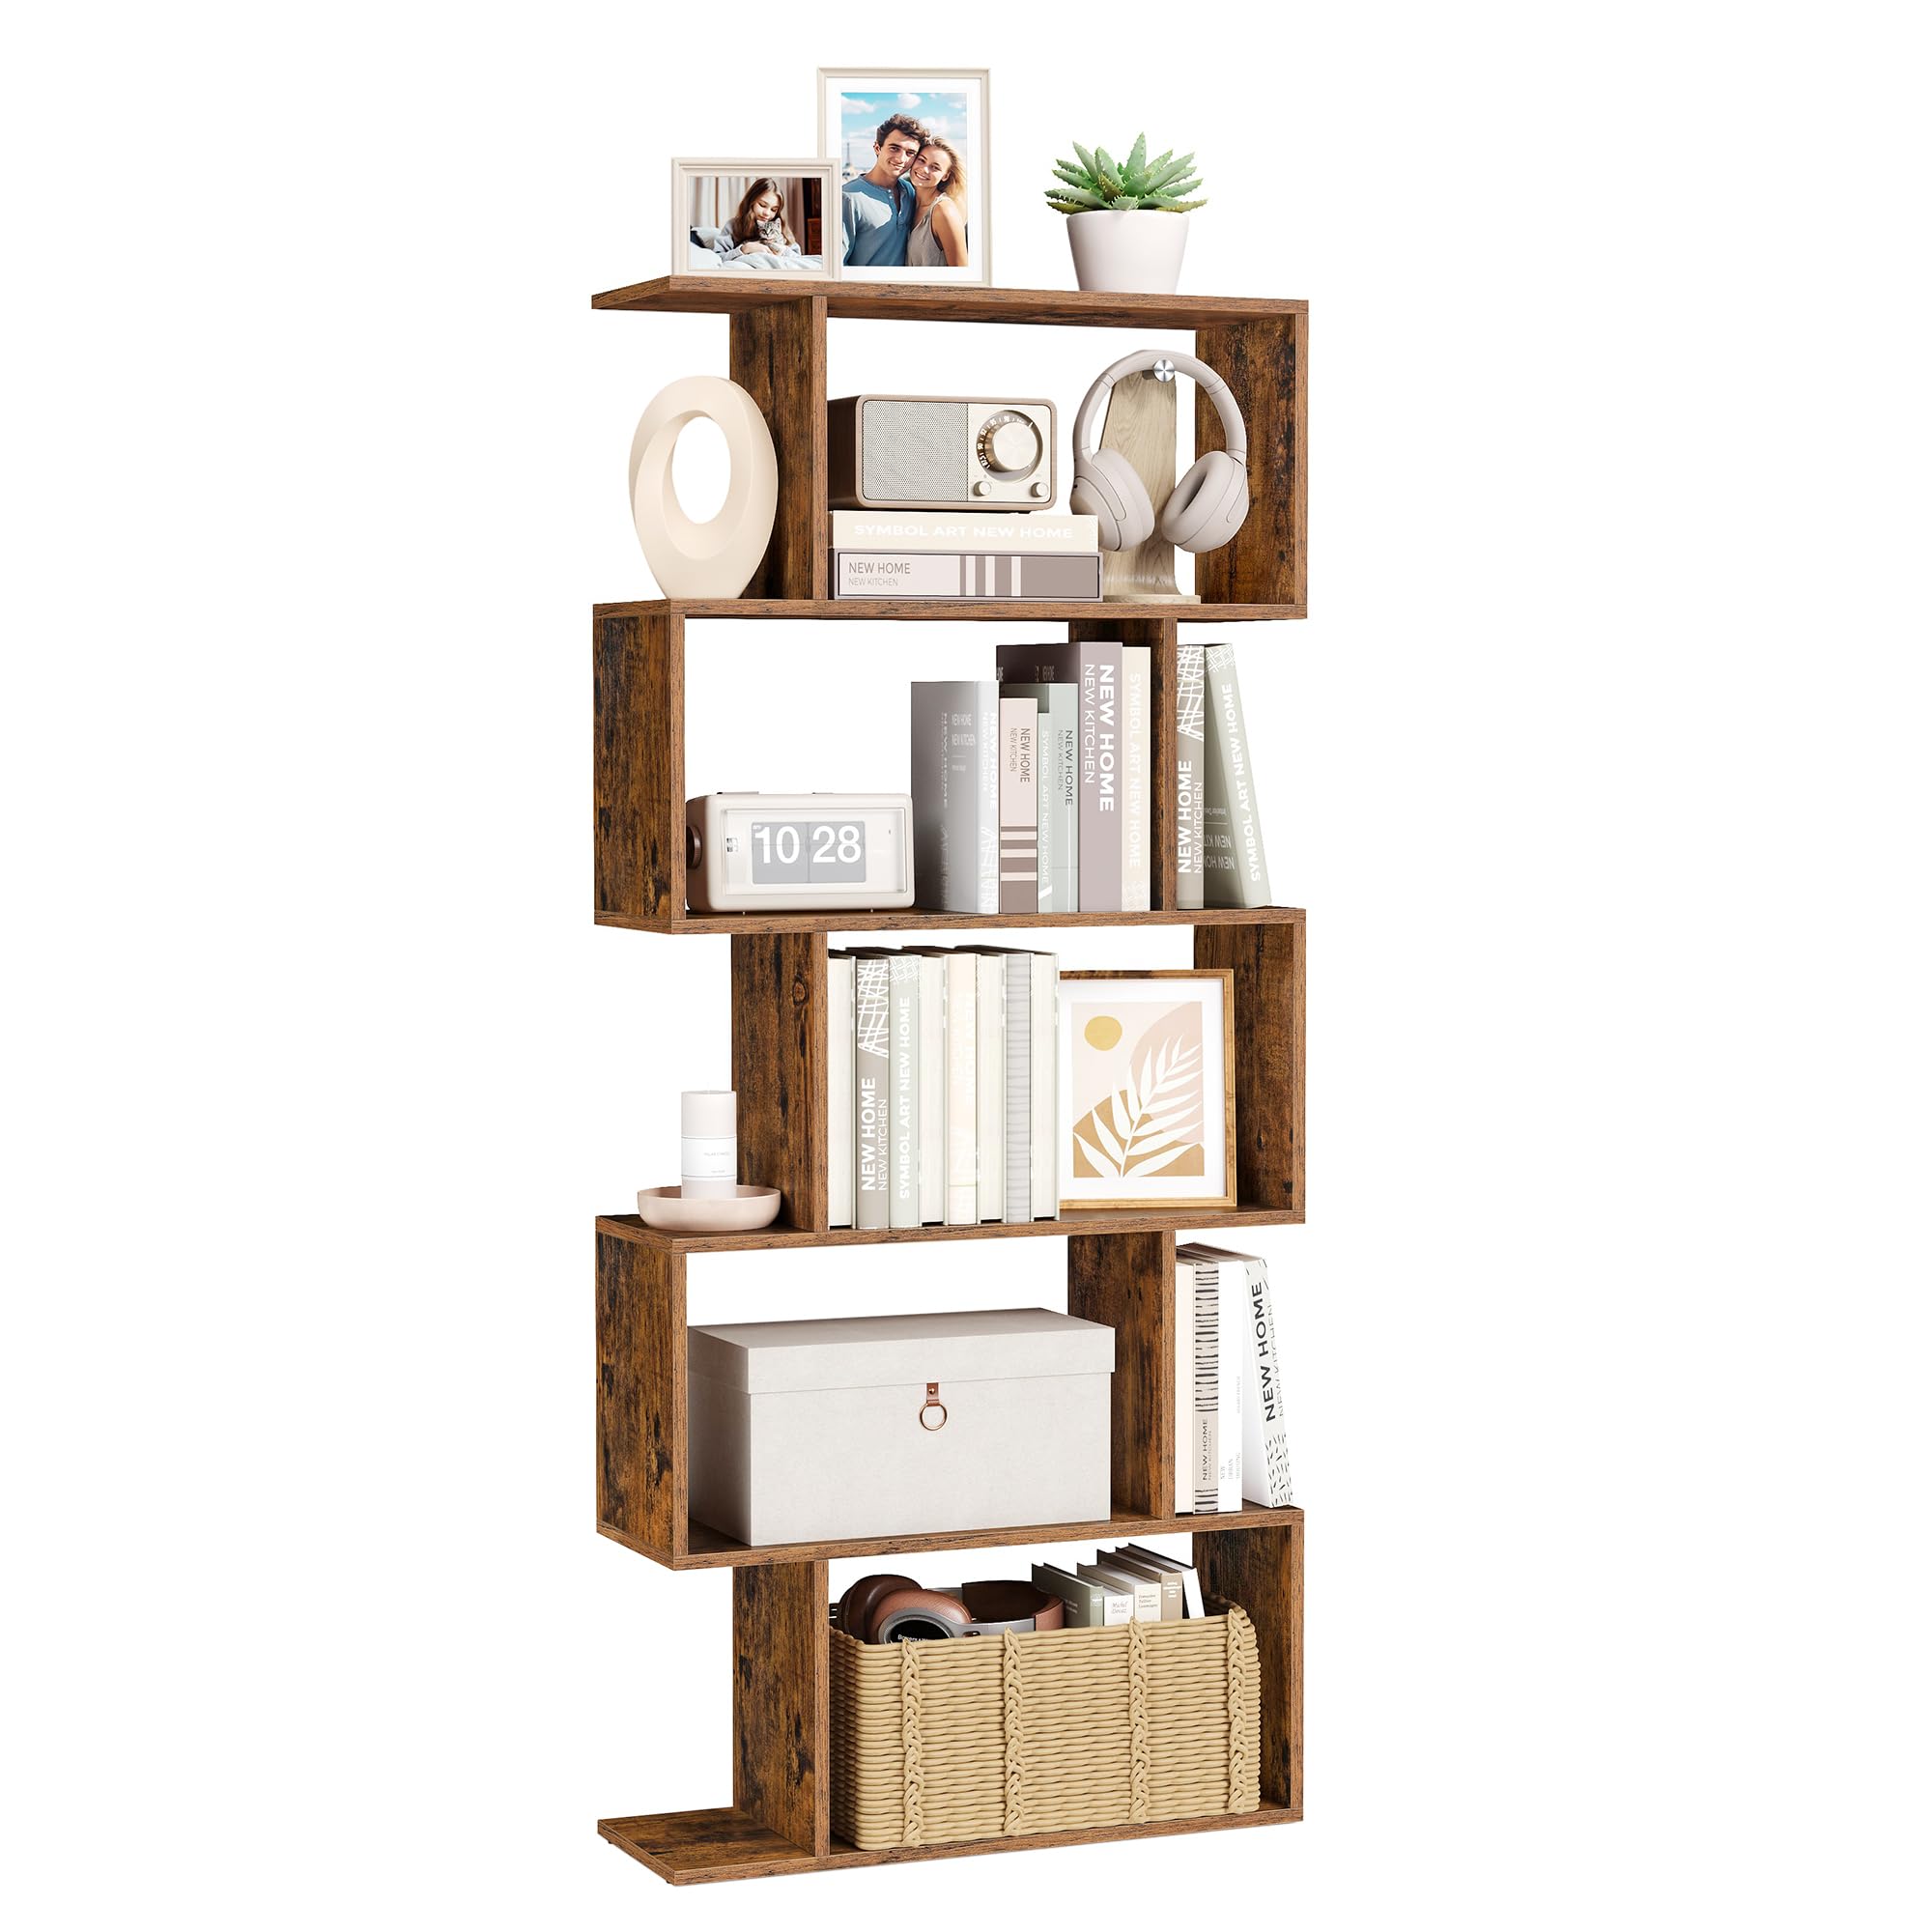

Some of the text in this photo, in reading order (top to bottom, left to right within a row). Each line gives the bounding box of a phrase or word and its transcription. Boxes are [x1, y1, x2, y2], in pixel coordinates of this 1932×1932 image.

[848, 577, 898, 587] NEW KITCHEN
[849, 562, 911, 574] NEW HOME
[854, 525, 1073, 539] SYMBOL ART NEW HOME
[1021, 727, 1030, 783] NEW HOME
[1084, 665, 1095, 783] NEW KITCHEN
[1099, 665, 1114, 812] NEW HOME
[1129, 673, 1141, 867] SYMBOL ART NEW HOME
[1041, 730, 1050, 883] SYMBOL ART NEW HOME
[1178, 760, 1192, 873] NEW HOME
[1194, 782, 1202, 874] NEW KITCHEN
[1222, 683, 1261, 881] SYMBOL ART NEW HOME
[754, 825, 862, 864] 10 28
[1215, 835, 1232, 848] NEW
[1218, 856, 1235, 869] NEW
[861, 1078, 876, 1191] NEW HOME
[878, 1099, 887, 1191] NEW KITCHEN
[899, 996, 909, 1199] SYMBOL ART NEW HOME
[1251, 1282, 1276, 1422] NEW HOME
